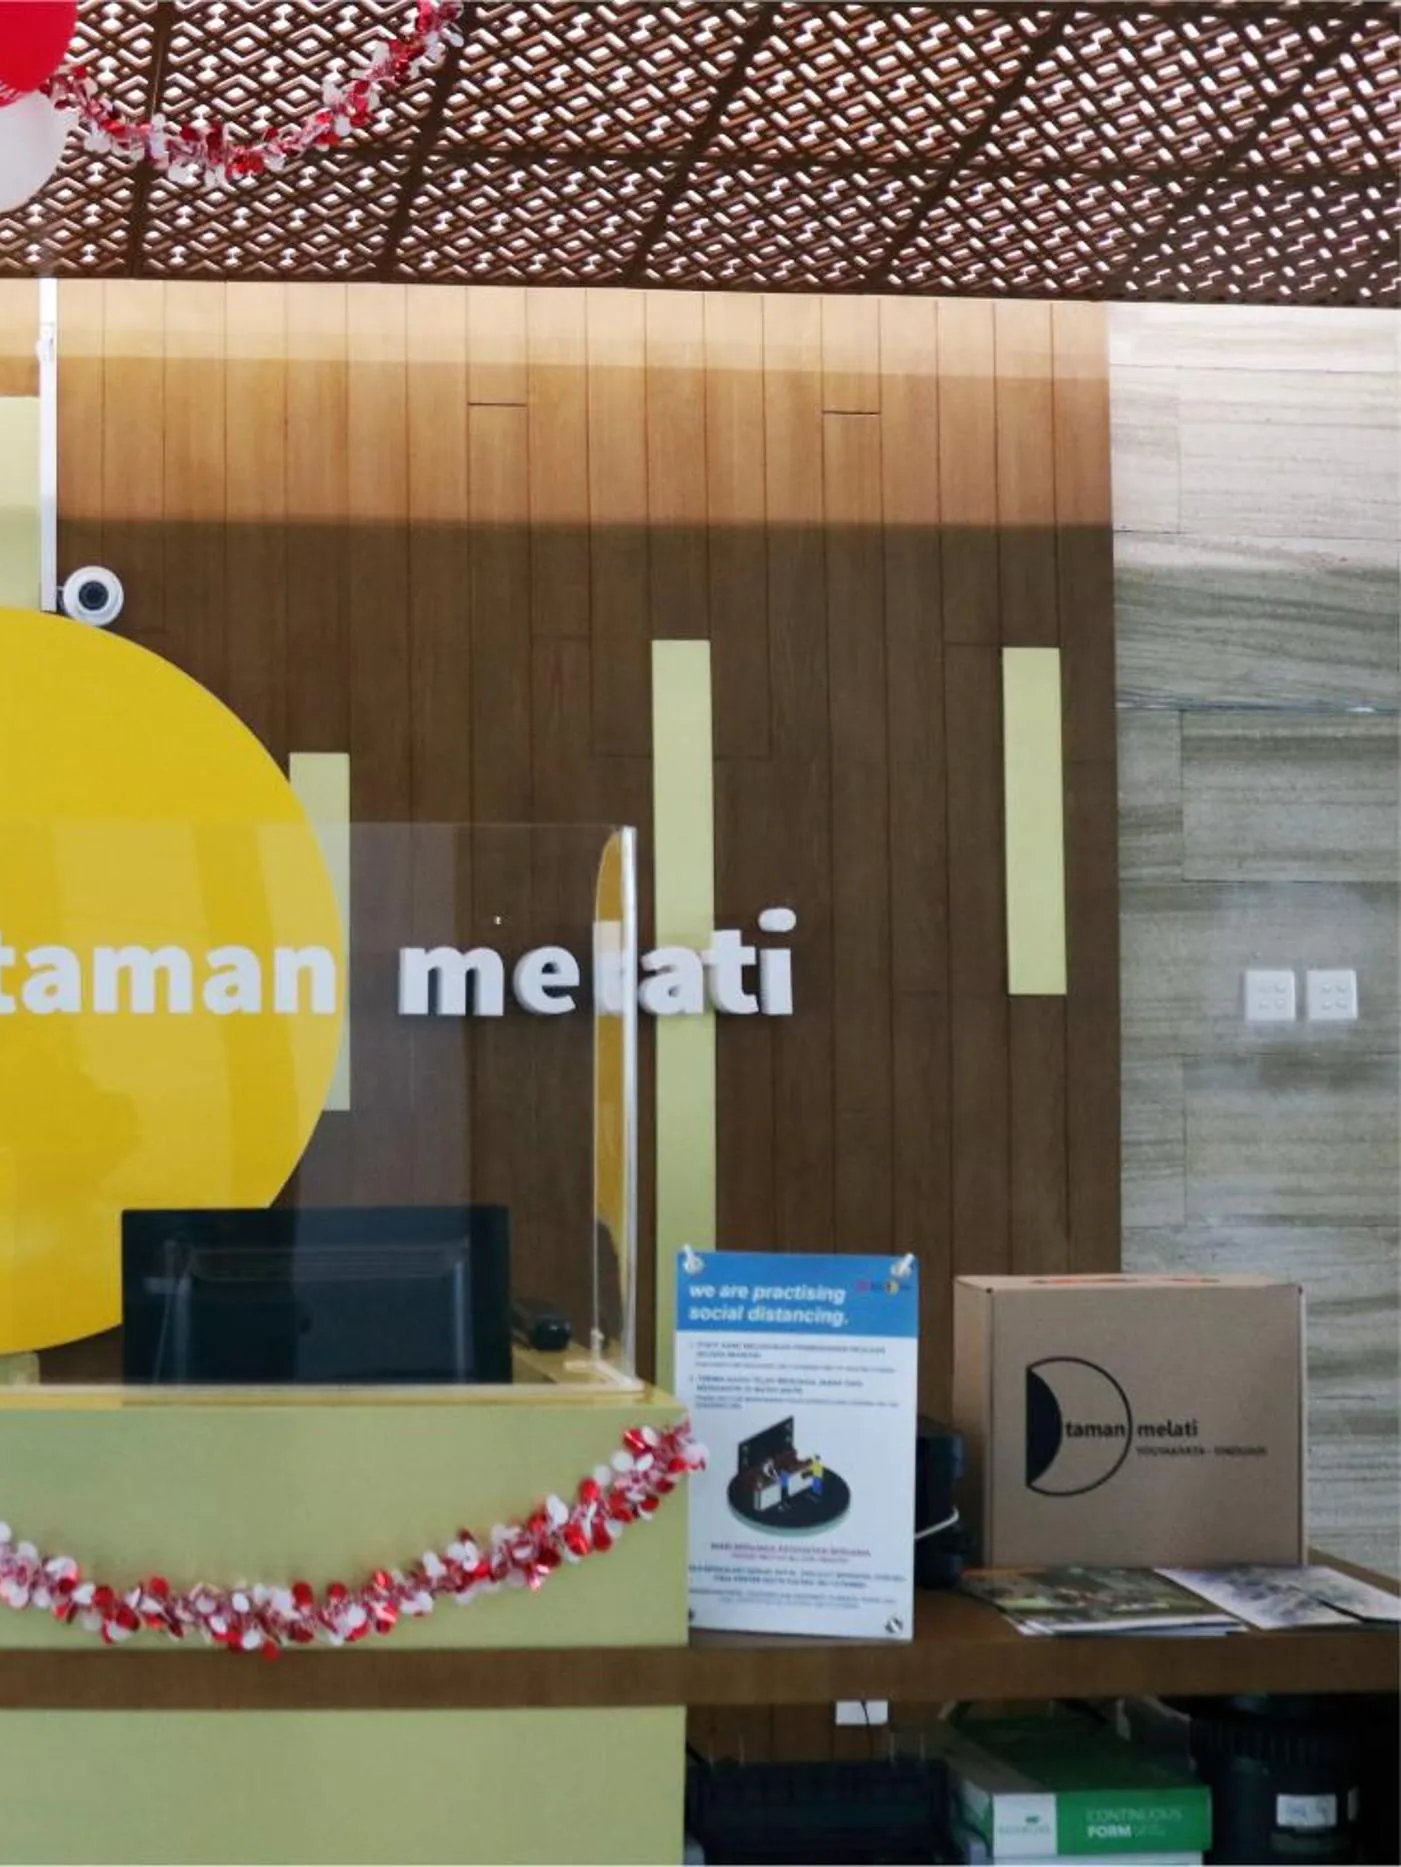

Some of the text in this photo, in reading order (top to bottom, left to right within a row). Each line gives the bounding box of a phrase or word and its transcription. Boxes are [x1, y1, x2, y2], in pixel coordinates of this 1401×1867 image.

[398, 907, 797, 1016] melati
[688, 1284, 716, 1298] we
[719, 1284, 749, 1299] are
[752, 1284, 847, 1305] practising
[688, 1304, 849, 1327] social distancing.
[1065, 1418, 1199, 1438] taman melati
[1087, 1824, 1132, 1839] FORM
